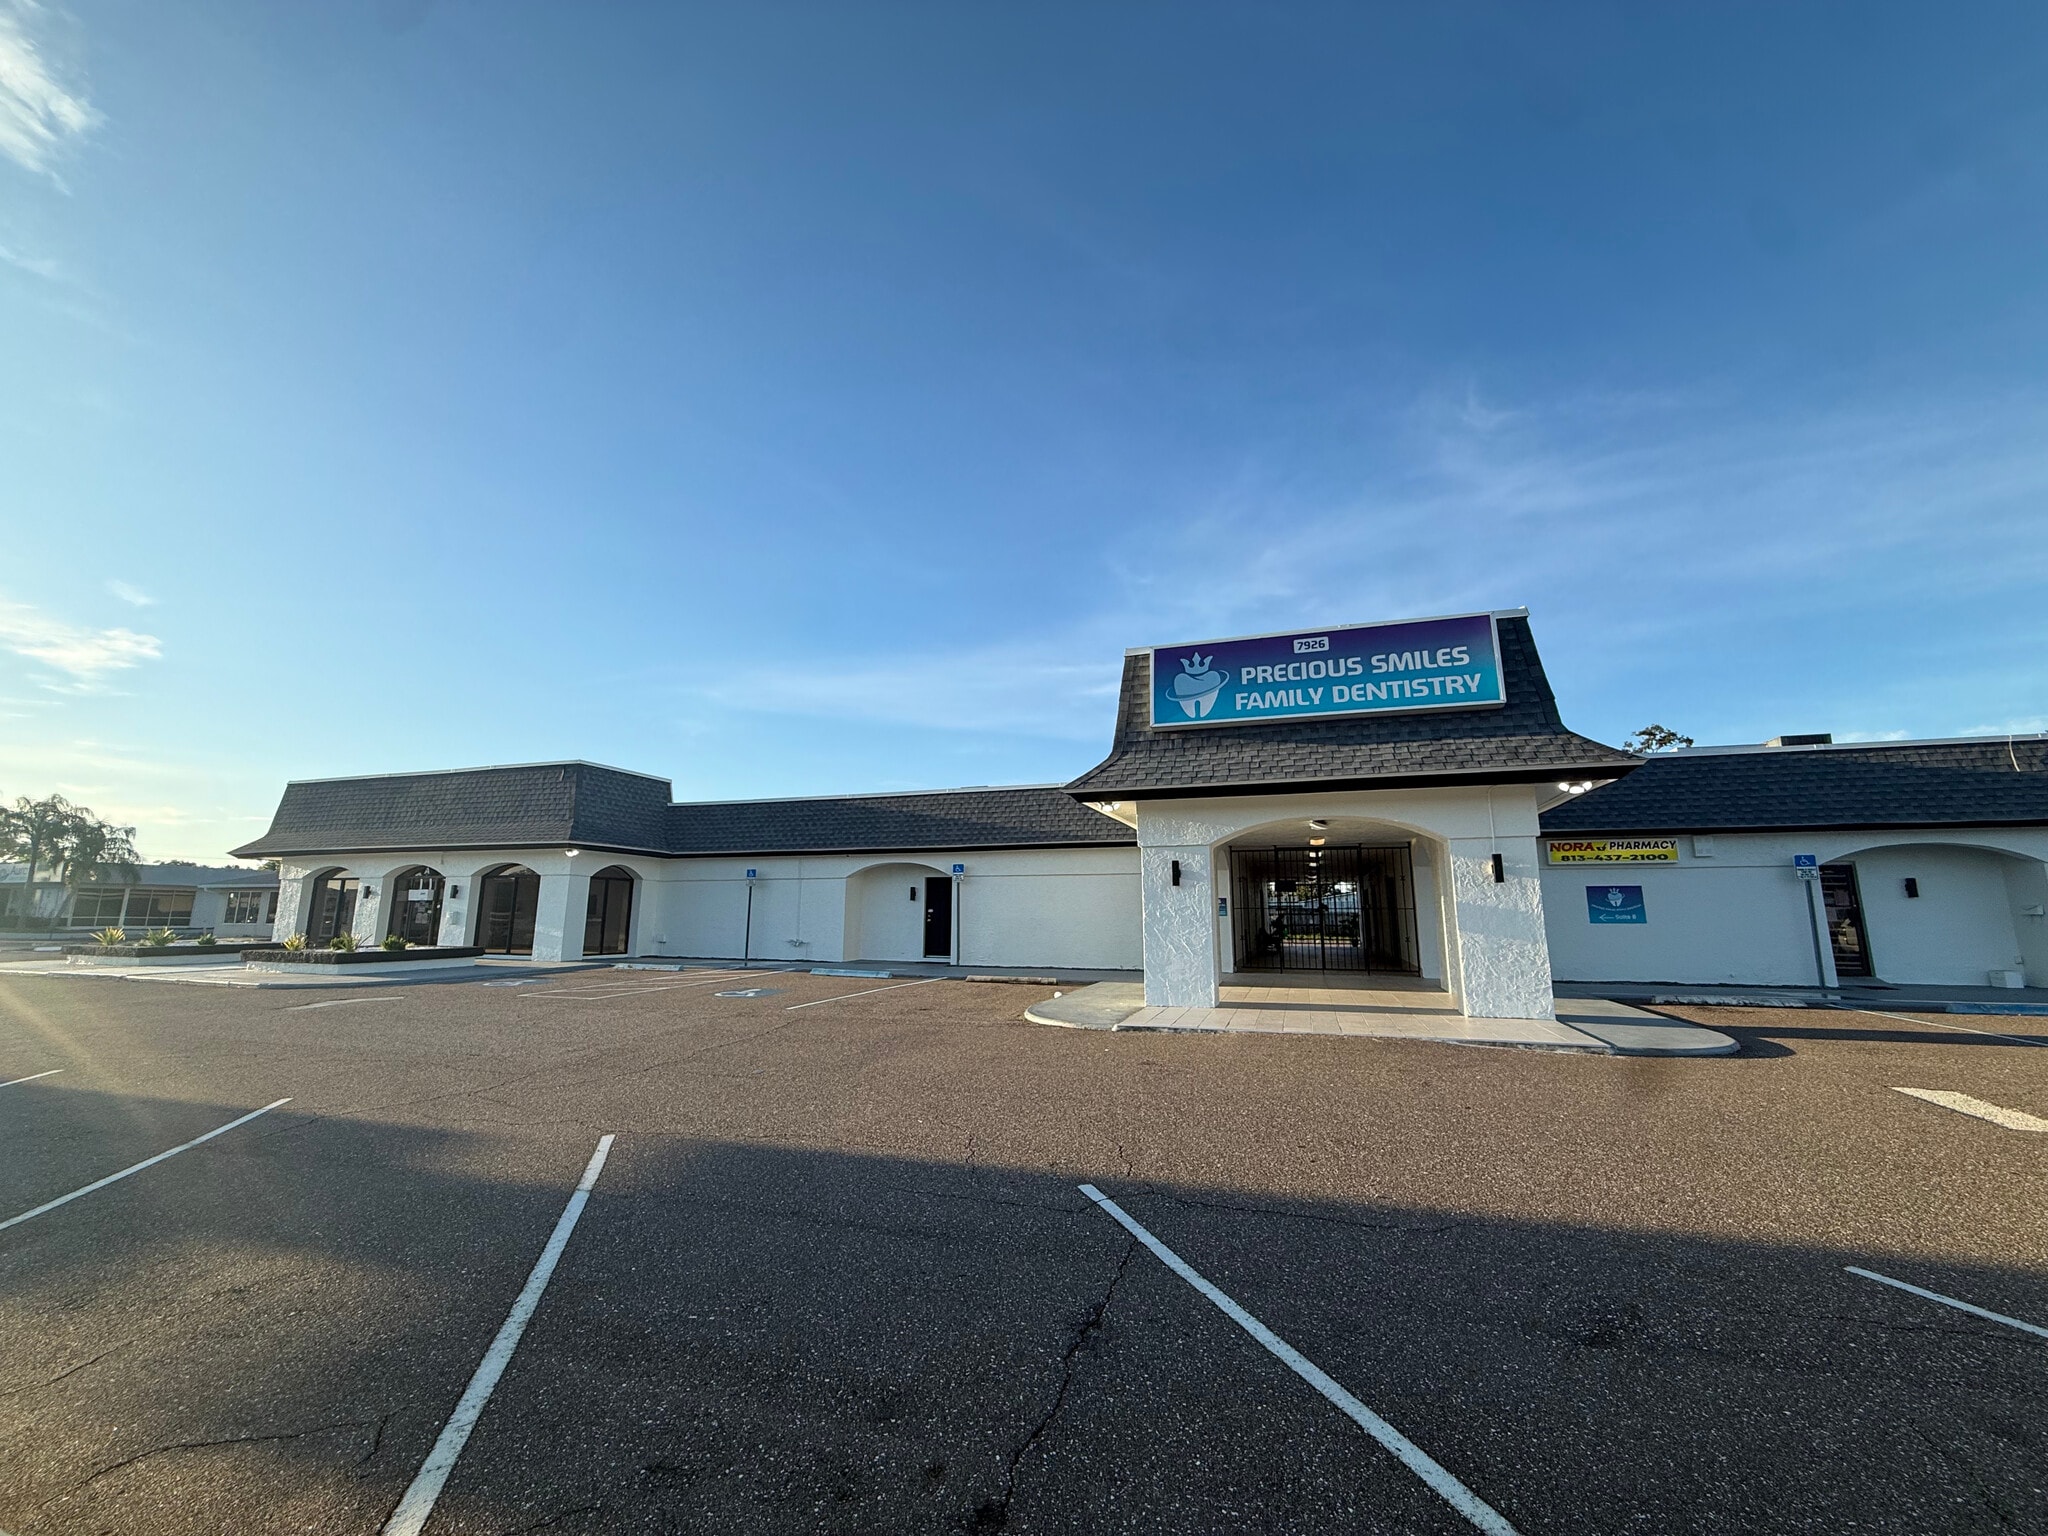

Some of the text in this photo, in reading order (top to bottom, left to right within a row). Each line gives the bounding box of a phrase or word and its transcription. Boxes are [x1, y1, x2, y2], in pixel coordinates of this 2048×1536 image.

[1296, 639, 1326, 651] 7926
[1241, 646, 1470, 685] PRECIOUS SMILES
[1235, 673, 1481, 710] FAMILY DENTISTRY
[1550, 841, 1676, 852] NORA PHARMACY
[1562, 854, 1669, 862] 813-437-2100
